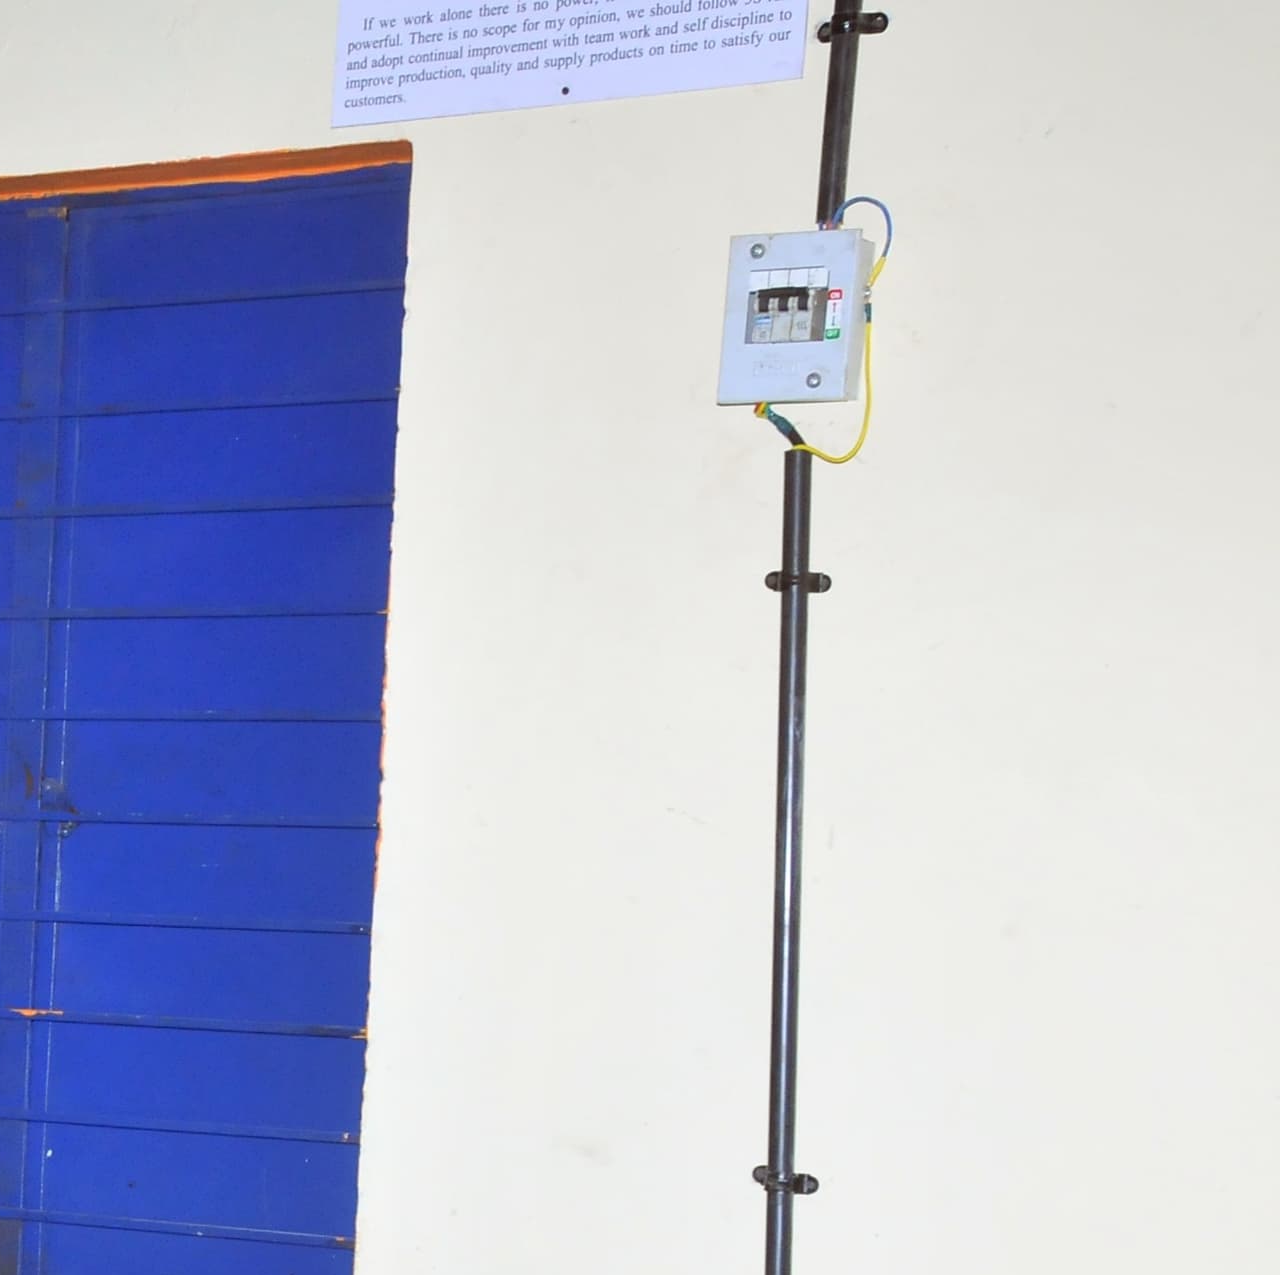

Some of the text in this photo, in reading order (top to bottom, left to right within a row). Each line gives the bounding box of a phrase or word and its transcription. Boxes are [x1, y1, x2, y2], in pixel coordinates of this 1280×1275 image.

[346, 10, 792, 71] and adopt continual improvement with team work and self discipline to
[347, 34, 403, 55] powerful.
[409, 32, 443, 45] There
[448, 28, 458, 41] is
[463, 28, 478, 39] no
[482, 23, 517, 38] scope
[523, 19, 541, 32] for
[545, 17, 565, 31] my
[569, 10, 620, 29] opinion,
[627, 8, 645, 19] we
[650, 0, 691, 17] should
[363, 17, 374, 31] If
[380, 17, 397, 28] we
[403, 11, 433, 26] work
[440, 8, 473, 22] alone
[479, 3, 509, 17] there
[516, 2, 527, 13] is
[533, 0, 549, 11] no
[345, 30, 792, 91] improve production, quality and supply products on time to satisfy our
[344, 93, 406, 109] customers.
